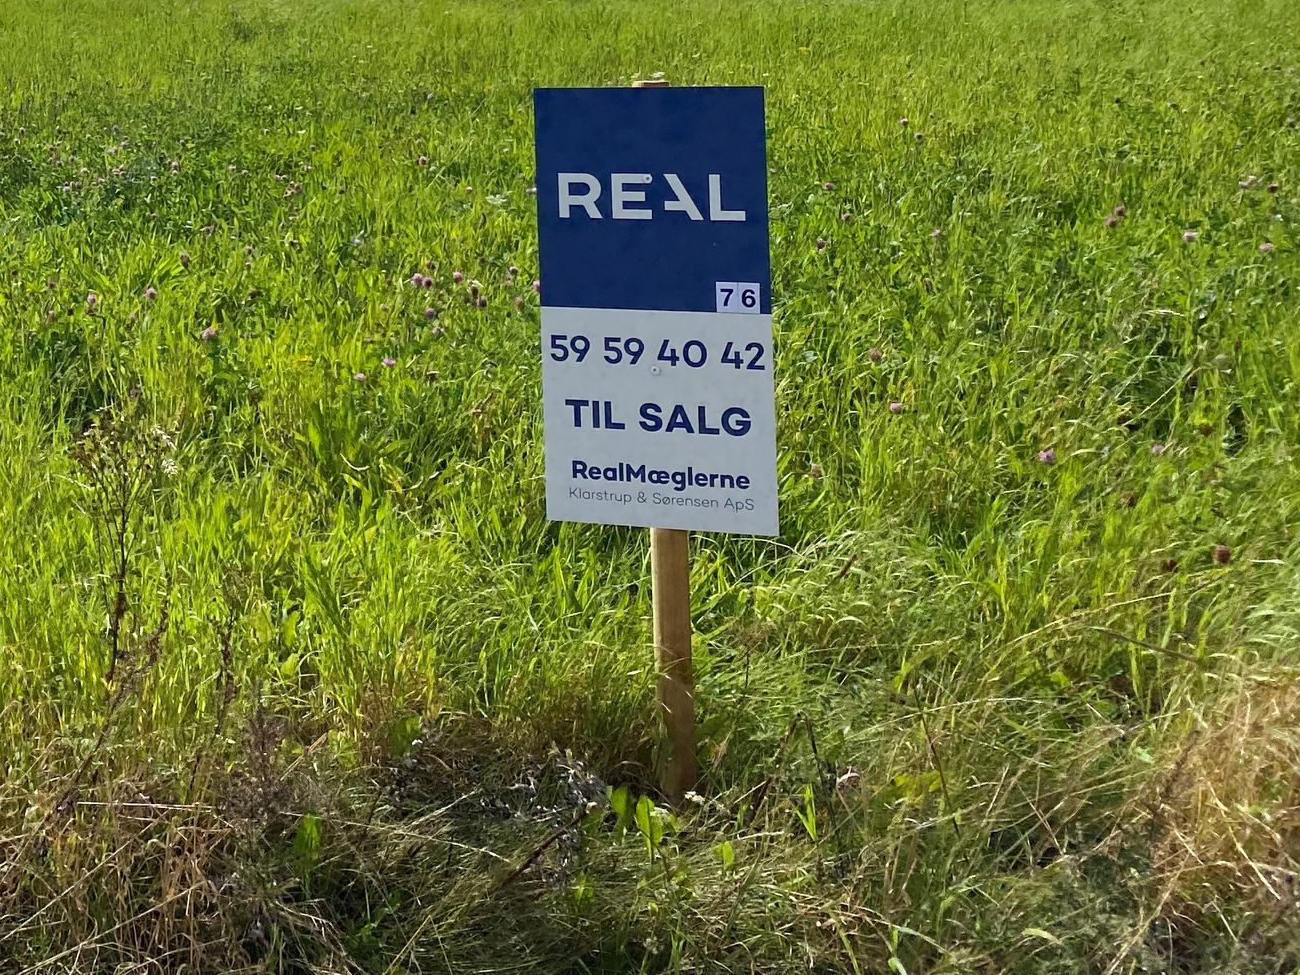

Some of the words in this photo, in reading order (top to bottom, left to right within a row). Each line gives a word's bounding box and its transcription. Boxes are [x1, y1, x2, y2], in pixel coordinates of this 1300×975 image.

[557, 172, 747, 222] REAL
[719, 287, 757, 309] 76
[549, 334, 591, 363] 59
[603, 336, 645, 365] 59
[656, 339, 708, 369] 40
[720, 341, 766, 371] 42
[564, 398, 626, 430] TIL
[638, 402, 752, 437] SALG
[571, 460, 751, 492] RealMæglerne
[568, 487, 633, 506] Klarstrup
[636, 491, 648, 504] &
[652, 492, 719, 509] Sørensen
[723, 497, 756, 513] ApS
